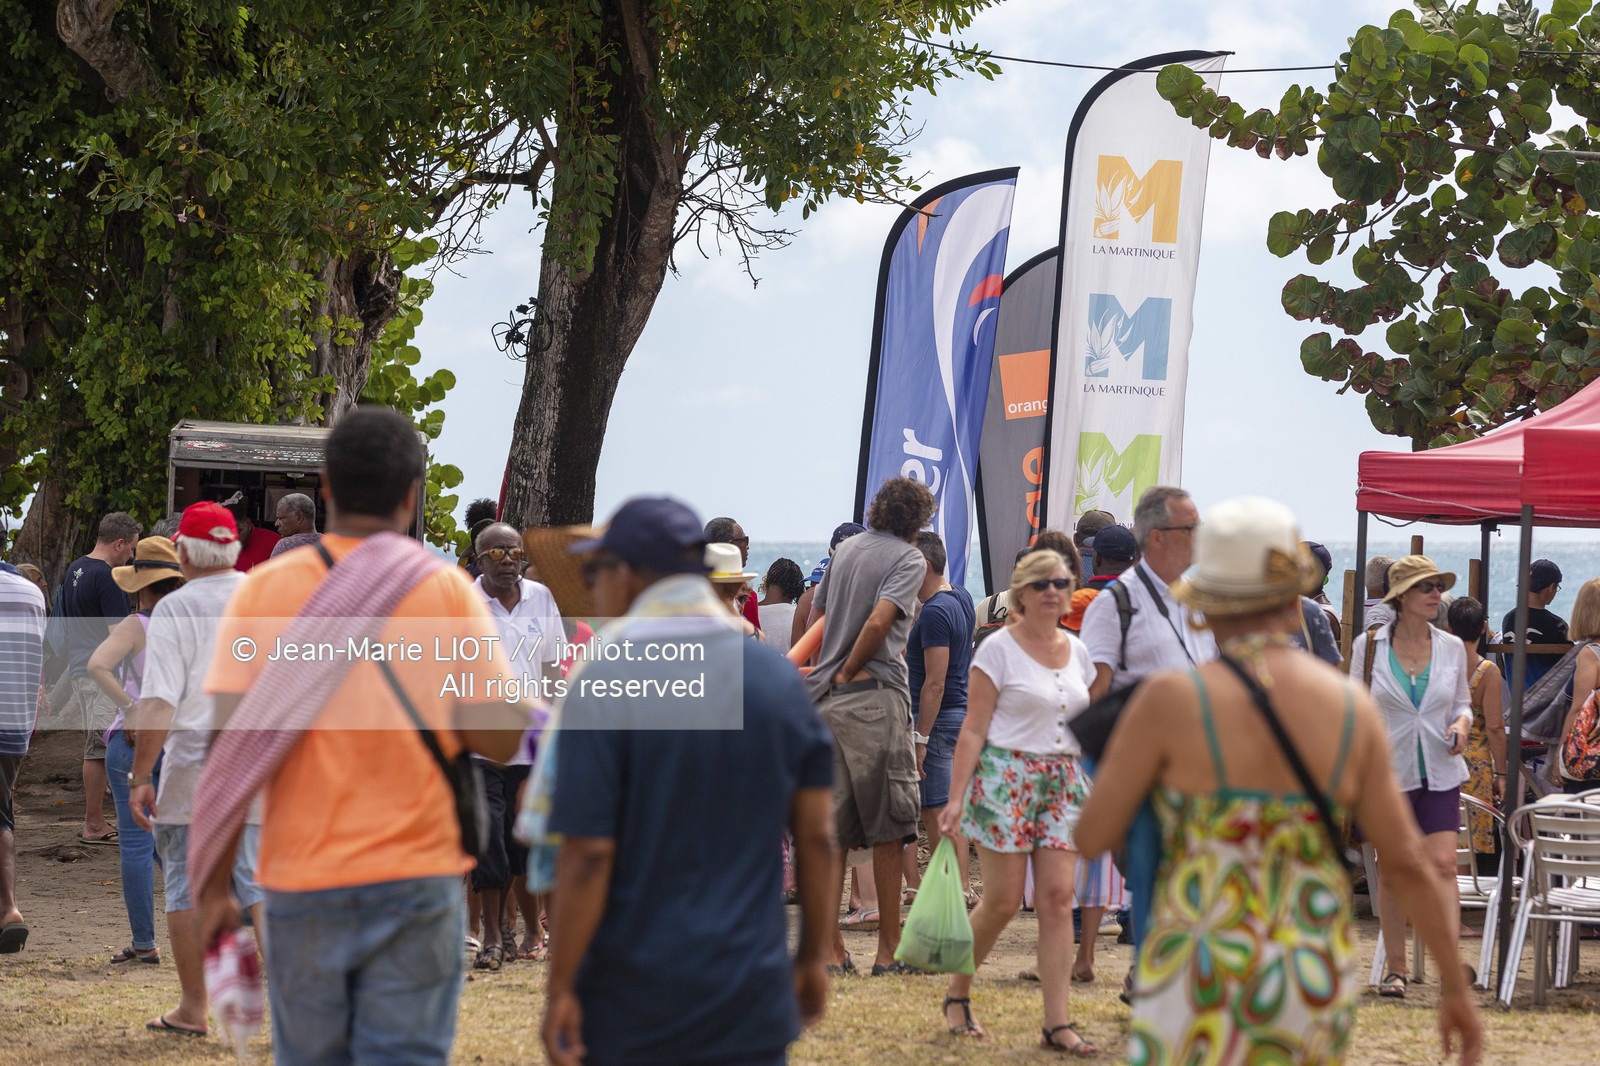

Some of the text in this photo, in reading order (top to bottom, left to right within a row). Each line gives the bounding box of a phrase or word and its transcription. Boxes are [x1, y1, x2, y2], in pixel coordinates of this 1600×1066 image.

[1092, 245, 1176, 260] LA MARTINIQUE
[1083, 384, 1166, 398] LA MARTINIQUE
